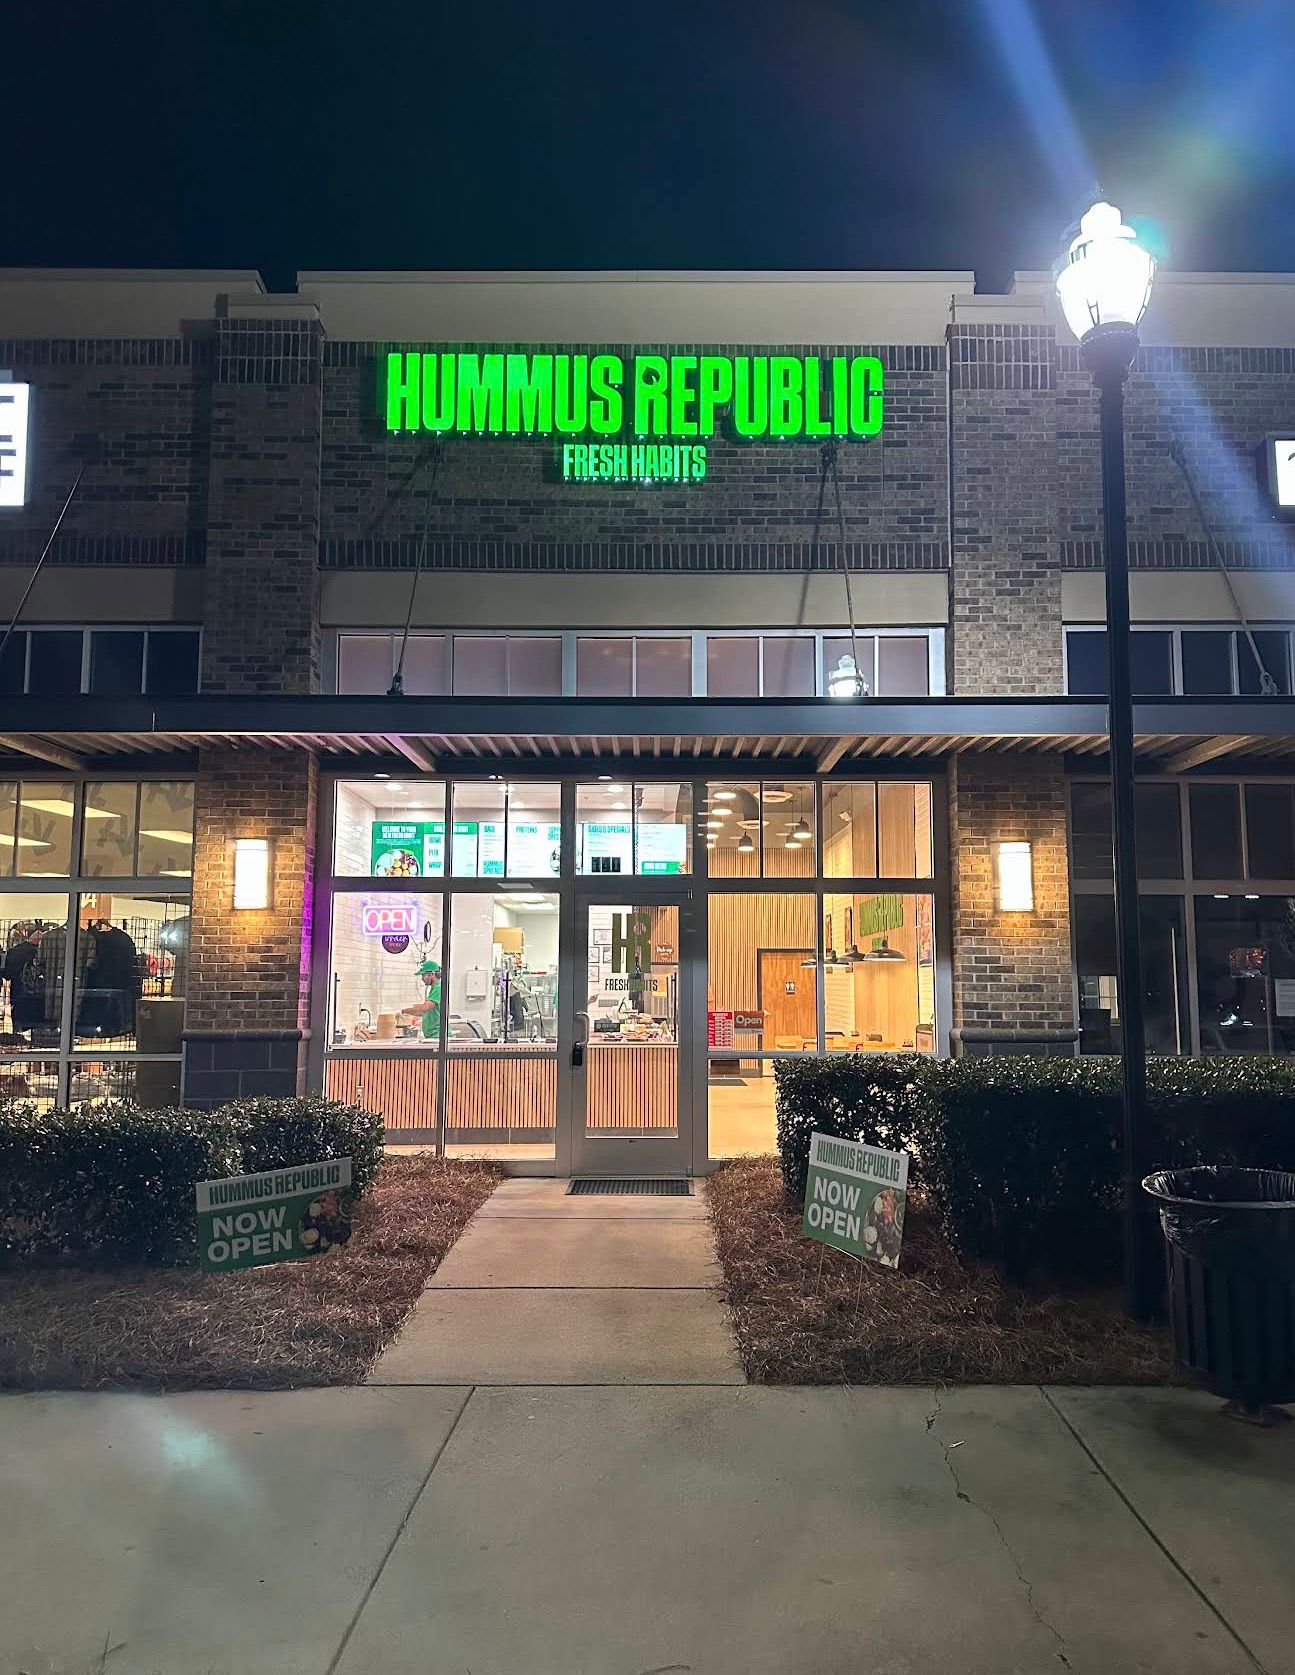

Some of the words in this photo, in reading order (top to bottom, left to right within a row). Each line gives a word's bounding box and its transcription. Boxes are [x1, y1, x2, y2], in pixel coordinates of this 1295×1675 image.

[387, 353, 623, 435] HUMMUS
[635, 355, 884, 437] REPUBLIC
[563, 444, 627, 477] FRESH
[631, 445, 706, 478] HABITS
[366, 910, 414, 930] OPEN
[611, 913, 651, 973] HR
[605, 979, 629, 990] FRESH
[736, 1015, 762, 1026] Open
[817, 1140, 857, 1171] HUMMUS
[856, 1151, 900, 1182] REPUBLIC
[209, 1176, 273, 1205] HUMMUS
[275, 1165, 340, 1194] REPUBLIC
[813, 1176, 861, 1211] NOW
[212, 1207, 286, 1239] NOW
[808, 1202, 861, 1241] OPEN
[207, 1229, 293, 1263] OPEN
